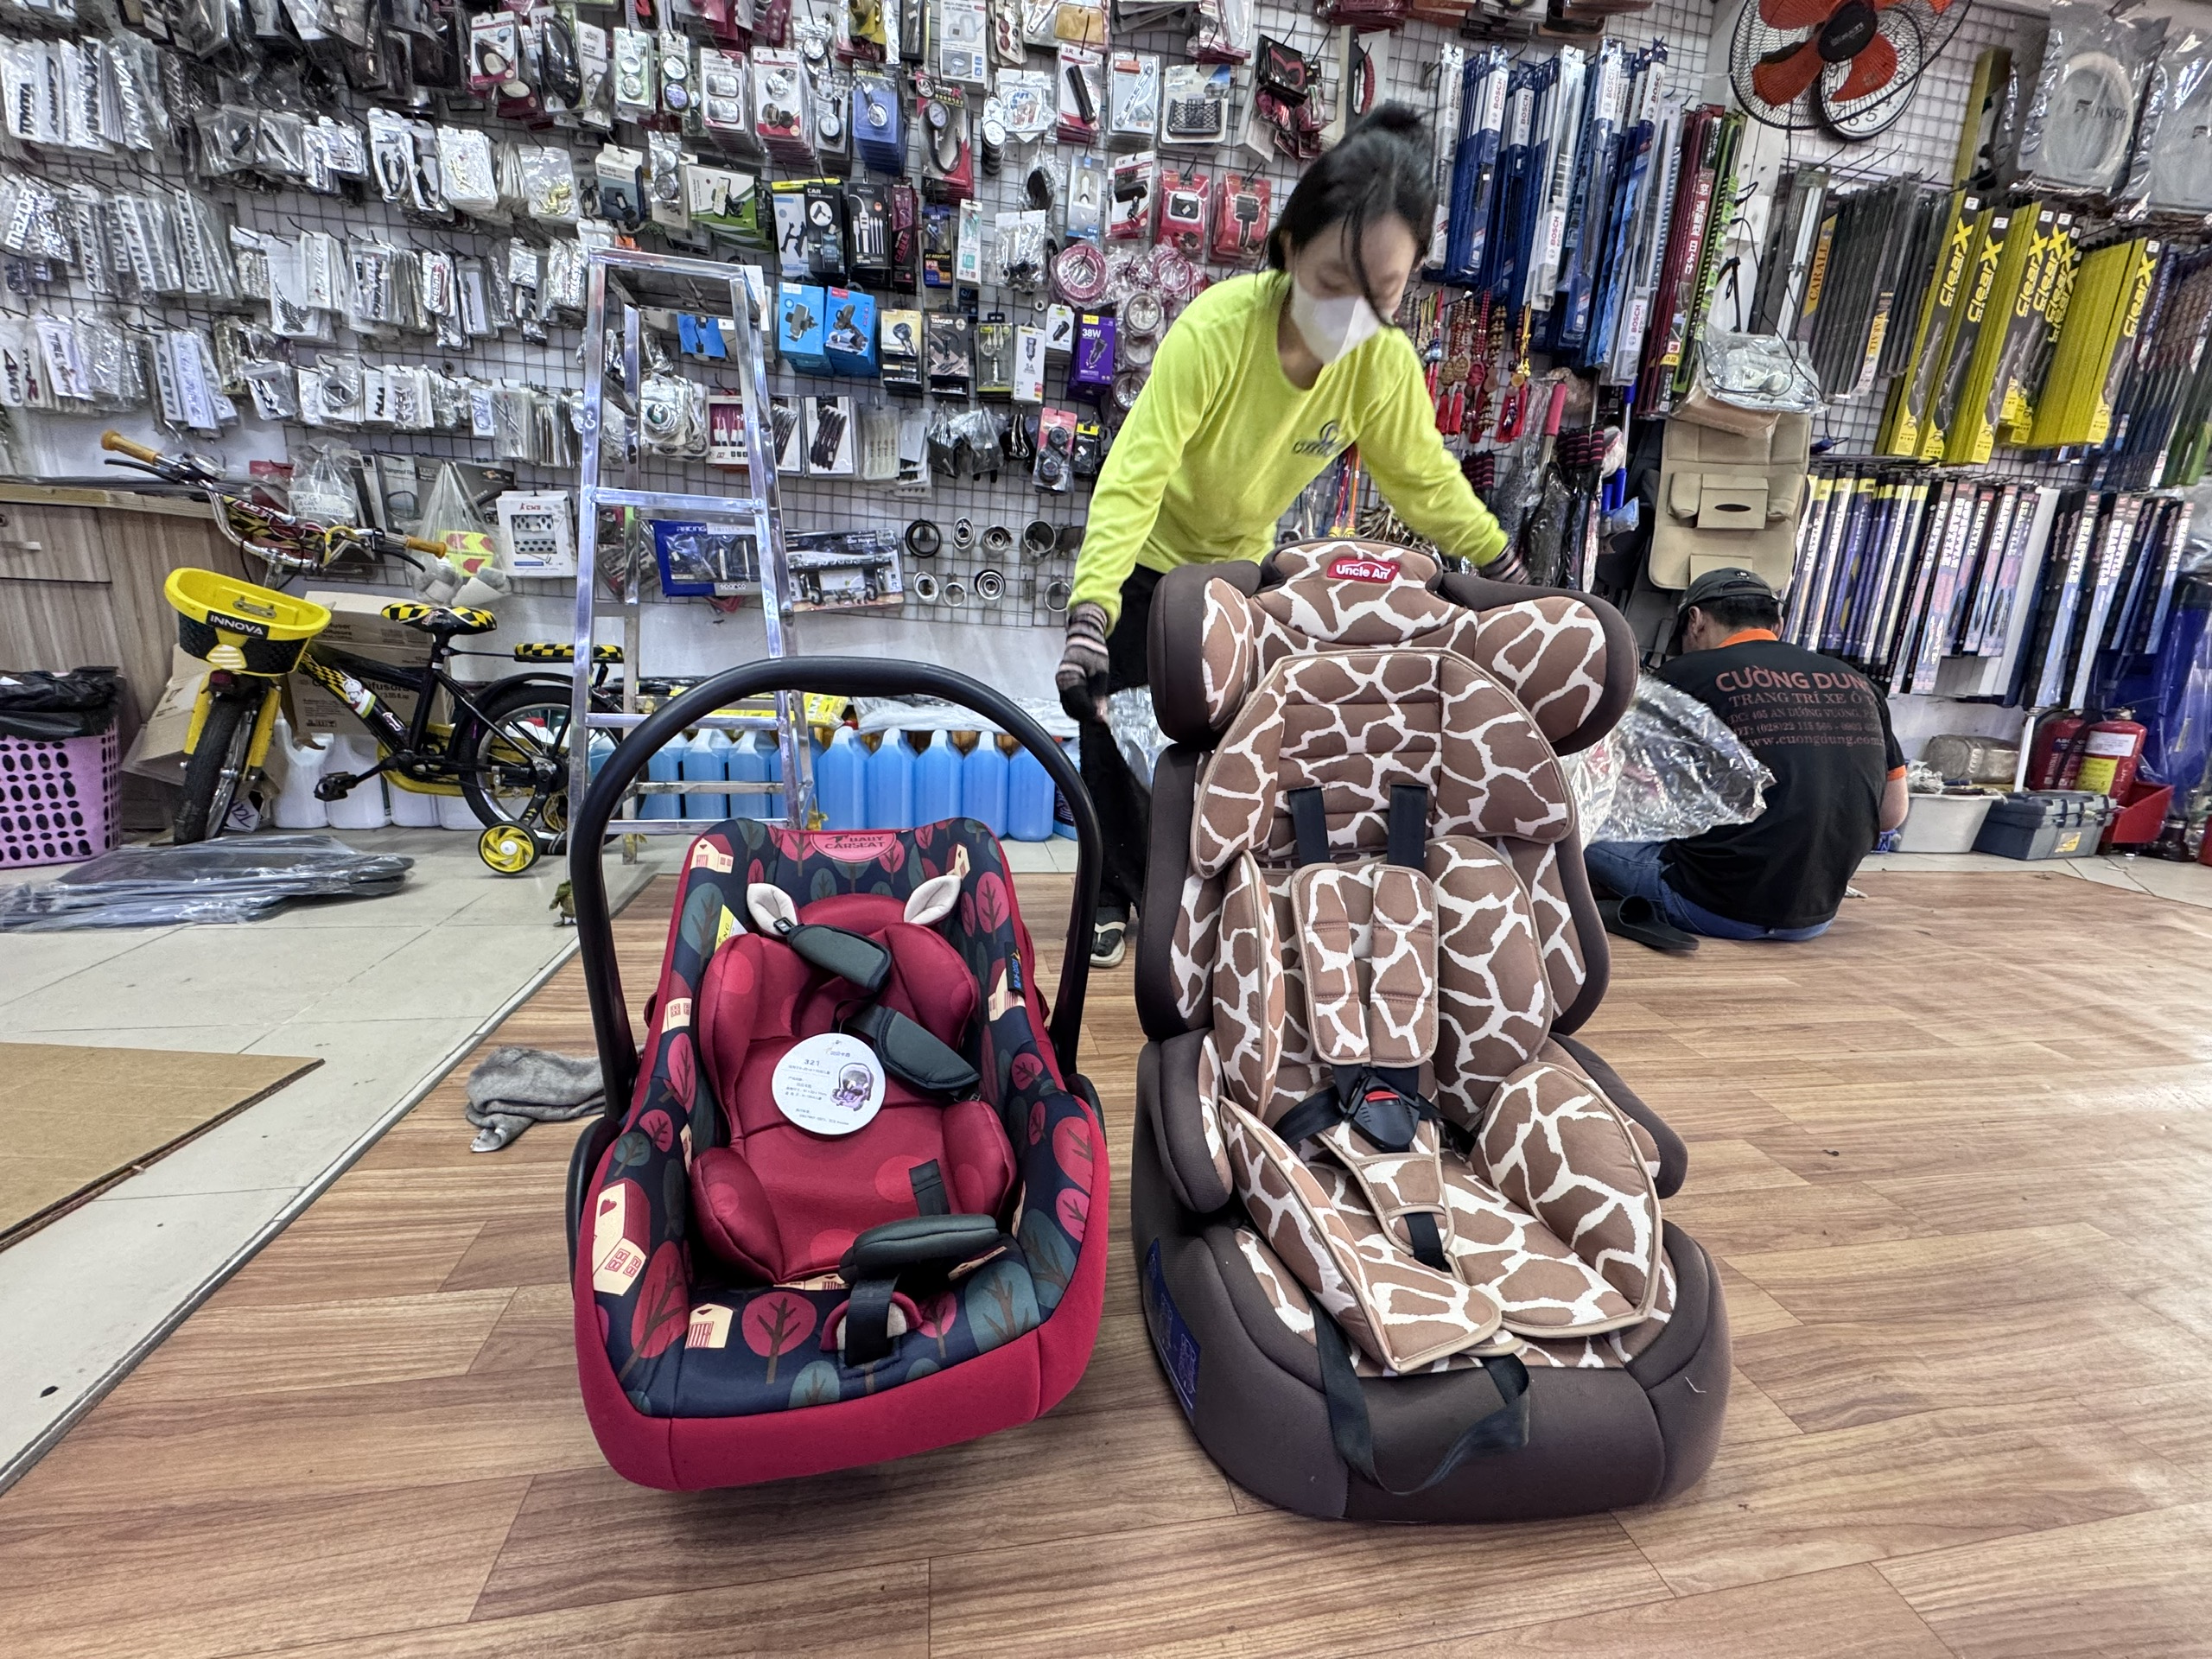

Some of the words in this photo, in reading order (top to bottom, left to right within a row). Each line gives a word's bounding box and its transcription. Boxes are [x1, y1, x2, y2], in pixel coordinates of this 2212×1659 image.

[19, 83, 35, 134] TOYOTA
[1493, 78, 1503, 109] BOSCH
[1550, 216, 1560, 246] BOSCH
[1809, 243, 1829, 302] CARALL
[1940, 217, 1974, 307] ClearX
[1967, 233, 2004, 322] ClearX
[2016, 229, 2049, 317] ClearX
[2033, 223, 2069, 311] ClearX
[1631, 304, 1642, 333] BOSCH
[2124, 251, 2158, 337] ClearX
[1082, 328, 1101, 338] 38W
[1924, 501, 1948, 569] SEASTYLE
[1941, 497, 1966, 566] SEASTYLE
[1967, 501, 1989, 556] SEASTYLE
[2008, 501, 2030, 556] SEASTYLE
[2068, 518, 2093, 583] SEASTYLE
[2098, 519, 2123, 586] SEASTYLE
[1336, 564, 1370, 577] Uncle
[210, 615, 264, 635] INNOVA
[1716, 665, 1810, 692] CƯỜNG
[1811, 672, 1872, 692] DUN
[1728, 692, 1789, 708] TRANG
[1791, 691, 1821, 704] TRÍ
[1825, 693, 1846, 704] XE
[1771, 708, 1785, 717] AN
